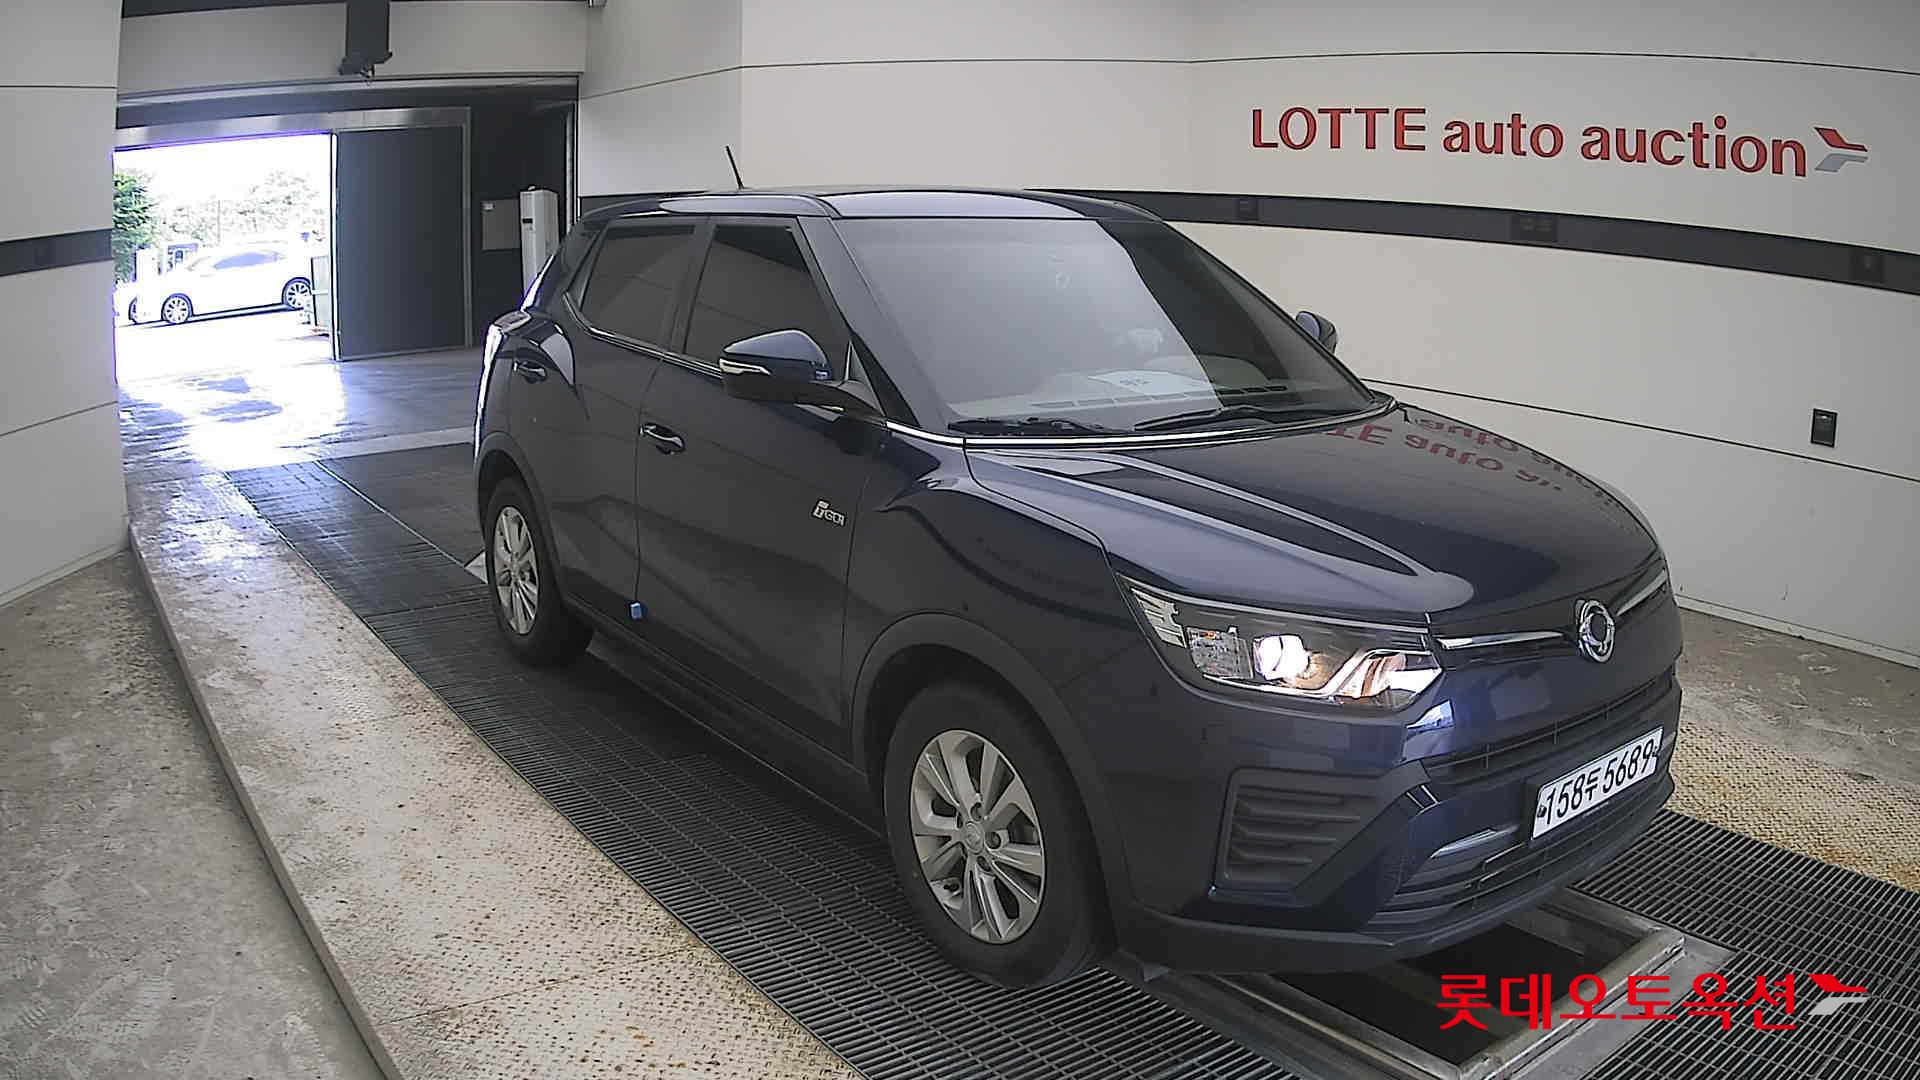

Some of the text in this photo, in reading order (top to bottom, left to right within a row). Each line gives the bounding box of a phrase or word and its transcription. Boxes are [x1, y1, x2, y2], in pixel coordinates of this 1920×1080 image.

[1252, 107, 1806, 178] LOTTE auto auction
[1602, 738, 1656, 794] 5689
